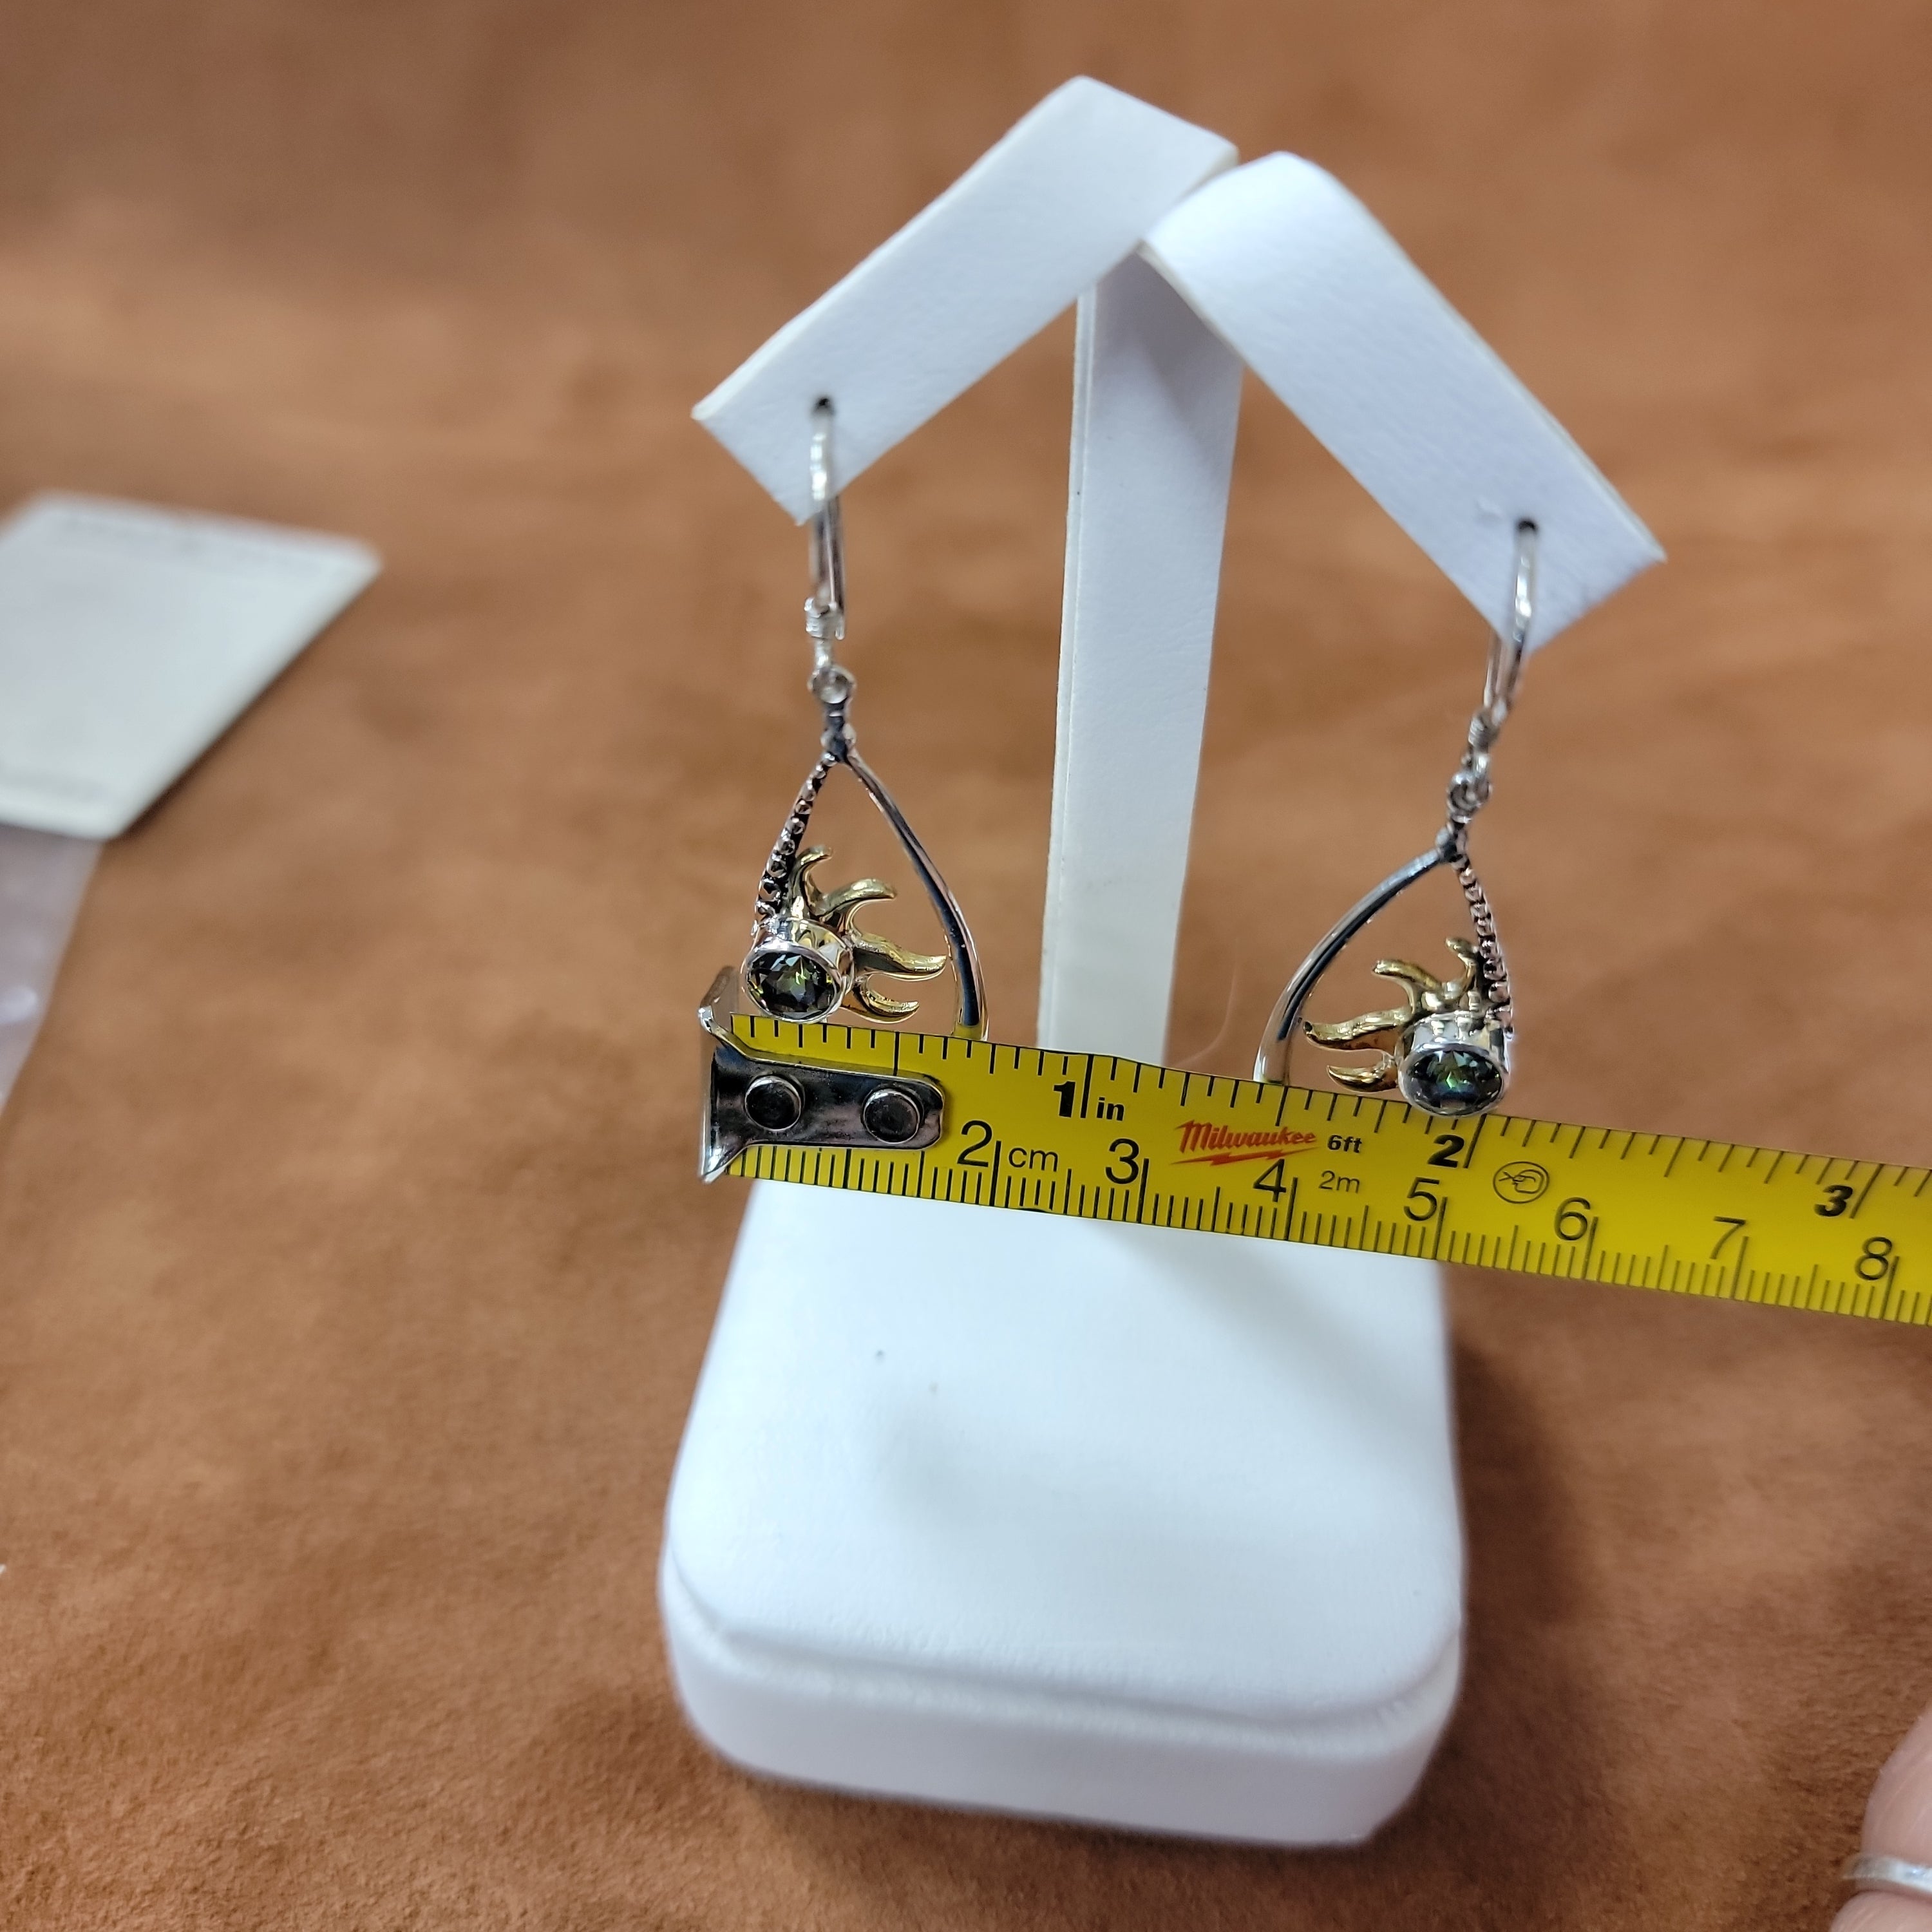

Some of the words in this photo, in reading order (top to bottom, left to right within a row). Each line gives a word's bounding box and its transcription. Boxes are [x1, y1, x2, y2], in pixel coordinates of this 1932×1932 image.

[1054, 1081, 1077, 1117] 1
[1096, 1097, 1125, 1121] in
[957, 1120, 992, 1167] 2
[1009, 1146, 1058, 1172] cm
[1174, 1119, 1316, 1153] Milwaukee
[1328, 1134, 1362, 1153] 6ft
[1428, 1134, 1464, 1168] 2
[1105, 1138, 1139, 1184] 3
[1253, 1159, 1287, 1202] 4
[1319, 1170, 1360, 1193] 2m
[1404, 1177, 1440, 1220] 5
[1553, 1197, 1591, 1242] 6
[1814, 1185, 1853, 1218] 3
[1710, 1216, 1746, 1260] 7
[1854, 1236, 1893, 1281] 8
